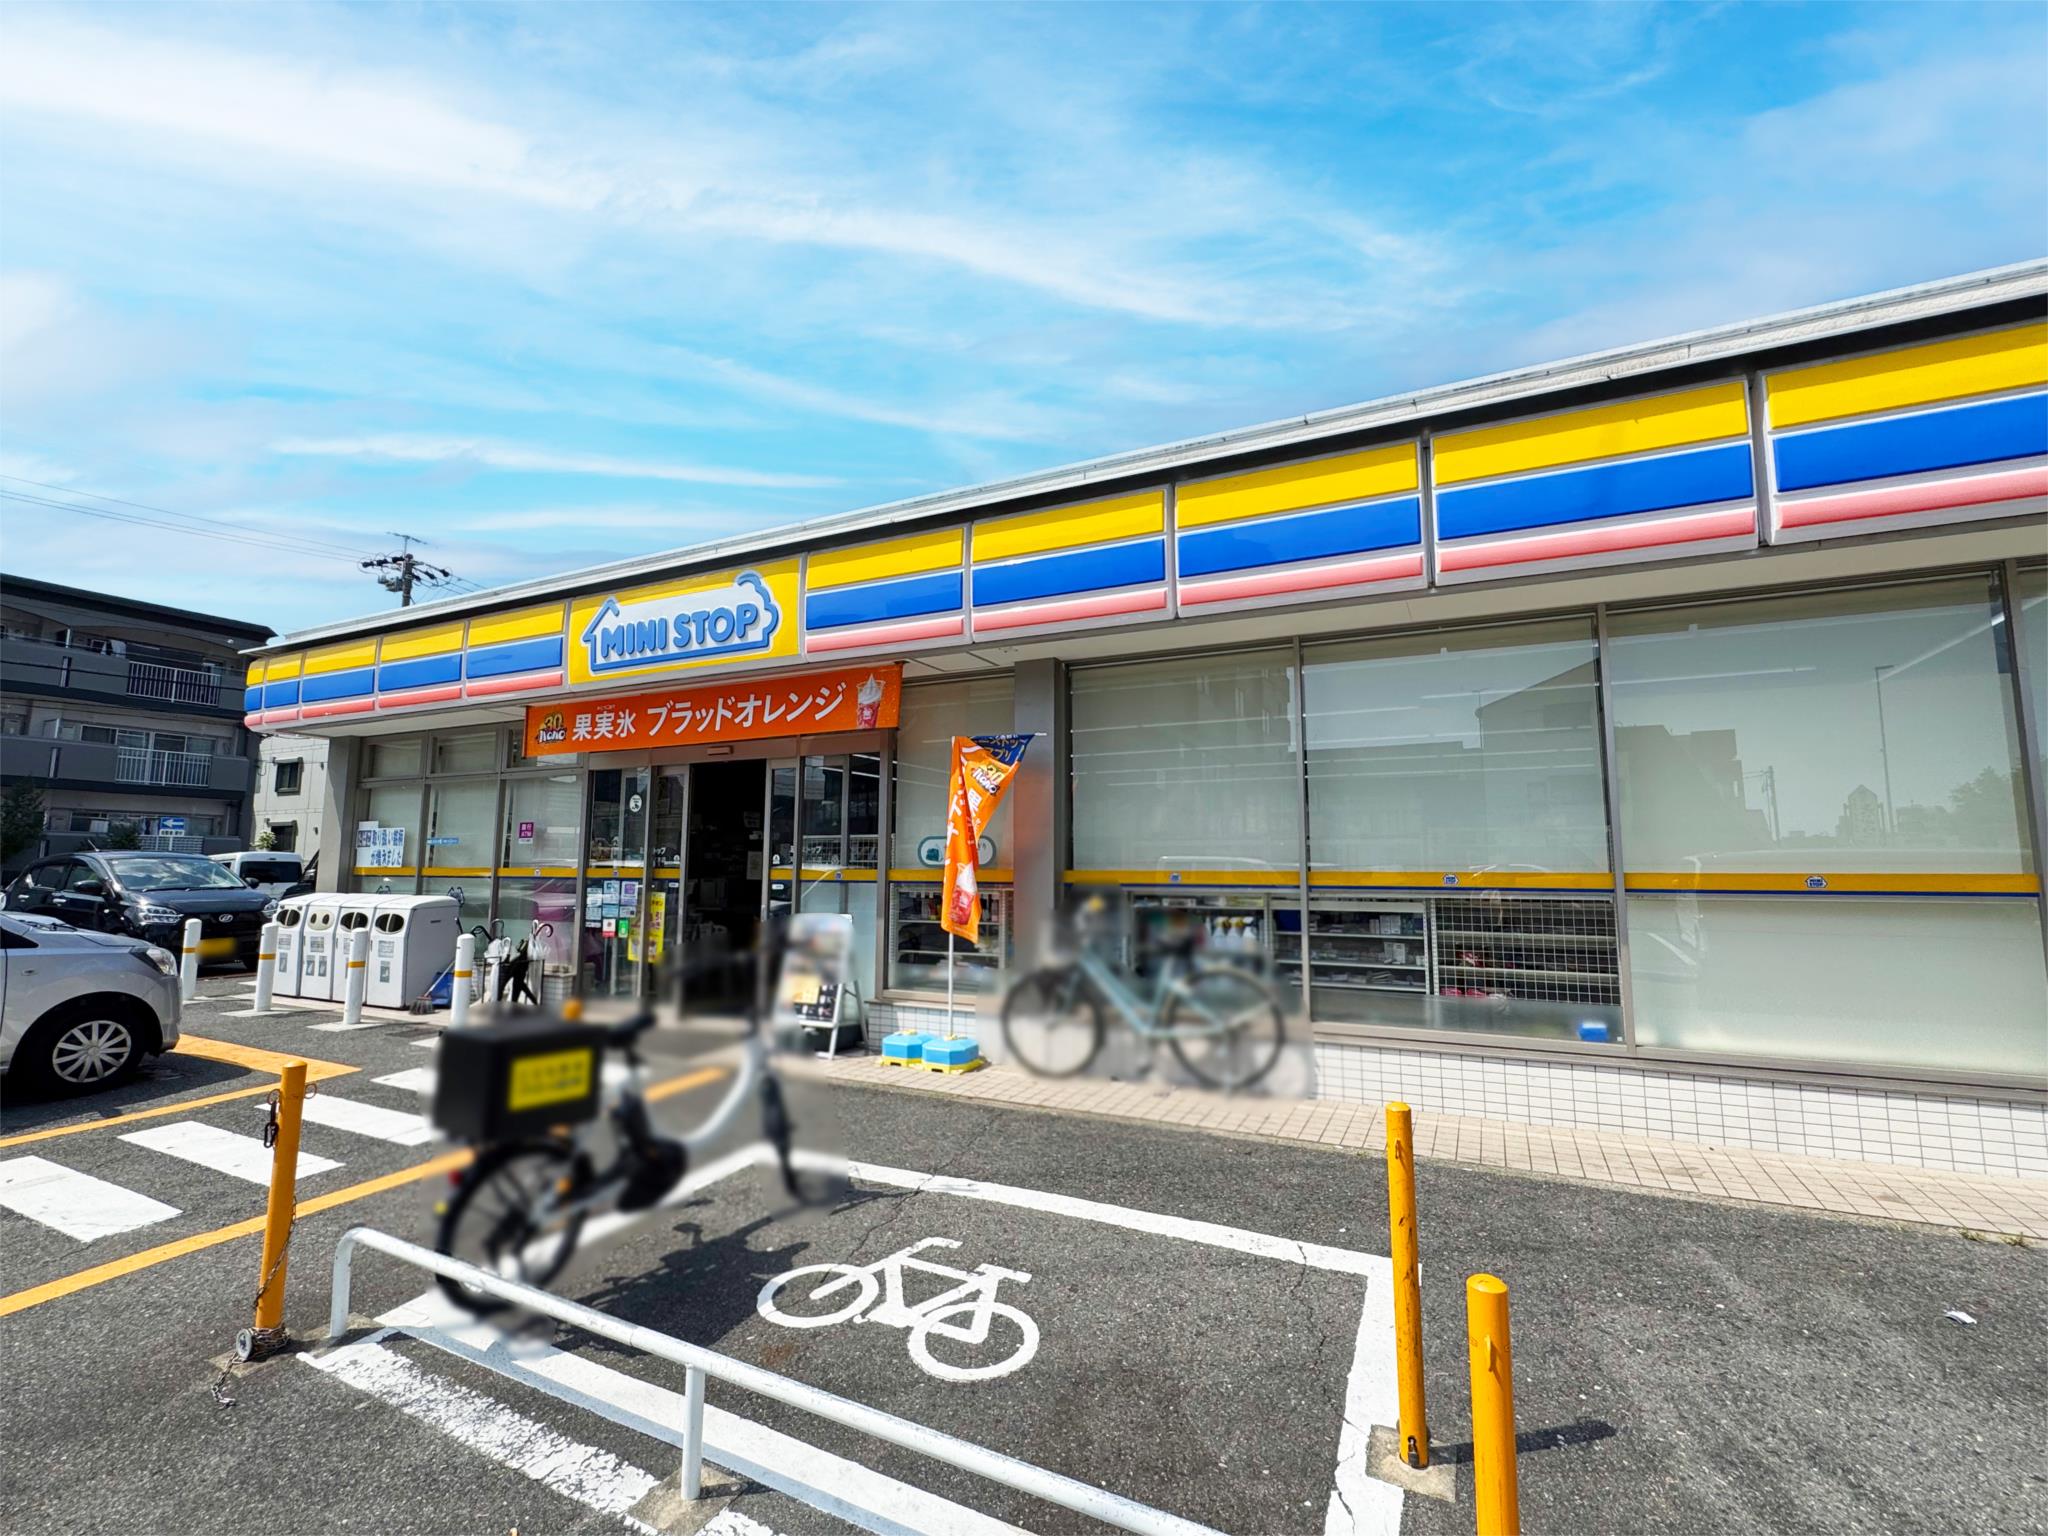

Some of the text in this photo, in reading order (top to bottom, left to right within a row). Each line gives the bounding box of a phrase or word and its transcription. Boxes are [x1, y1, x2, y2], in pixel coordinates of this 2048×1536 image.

[601, 603, 758, 658] MINI STOP
[572, 682, 847, 741] 果実氷 ブラッドオレンジ
